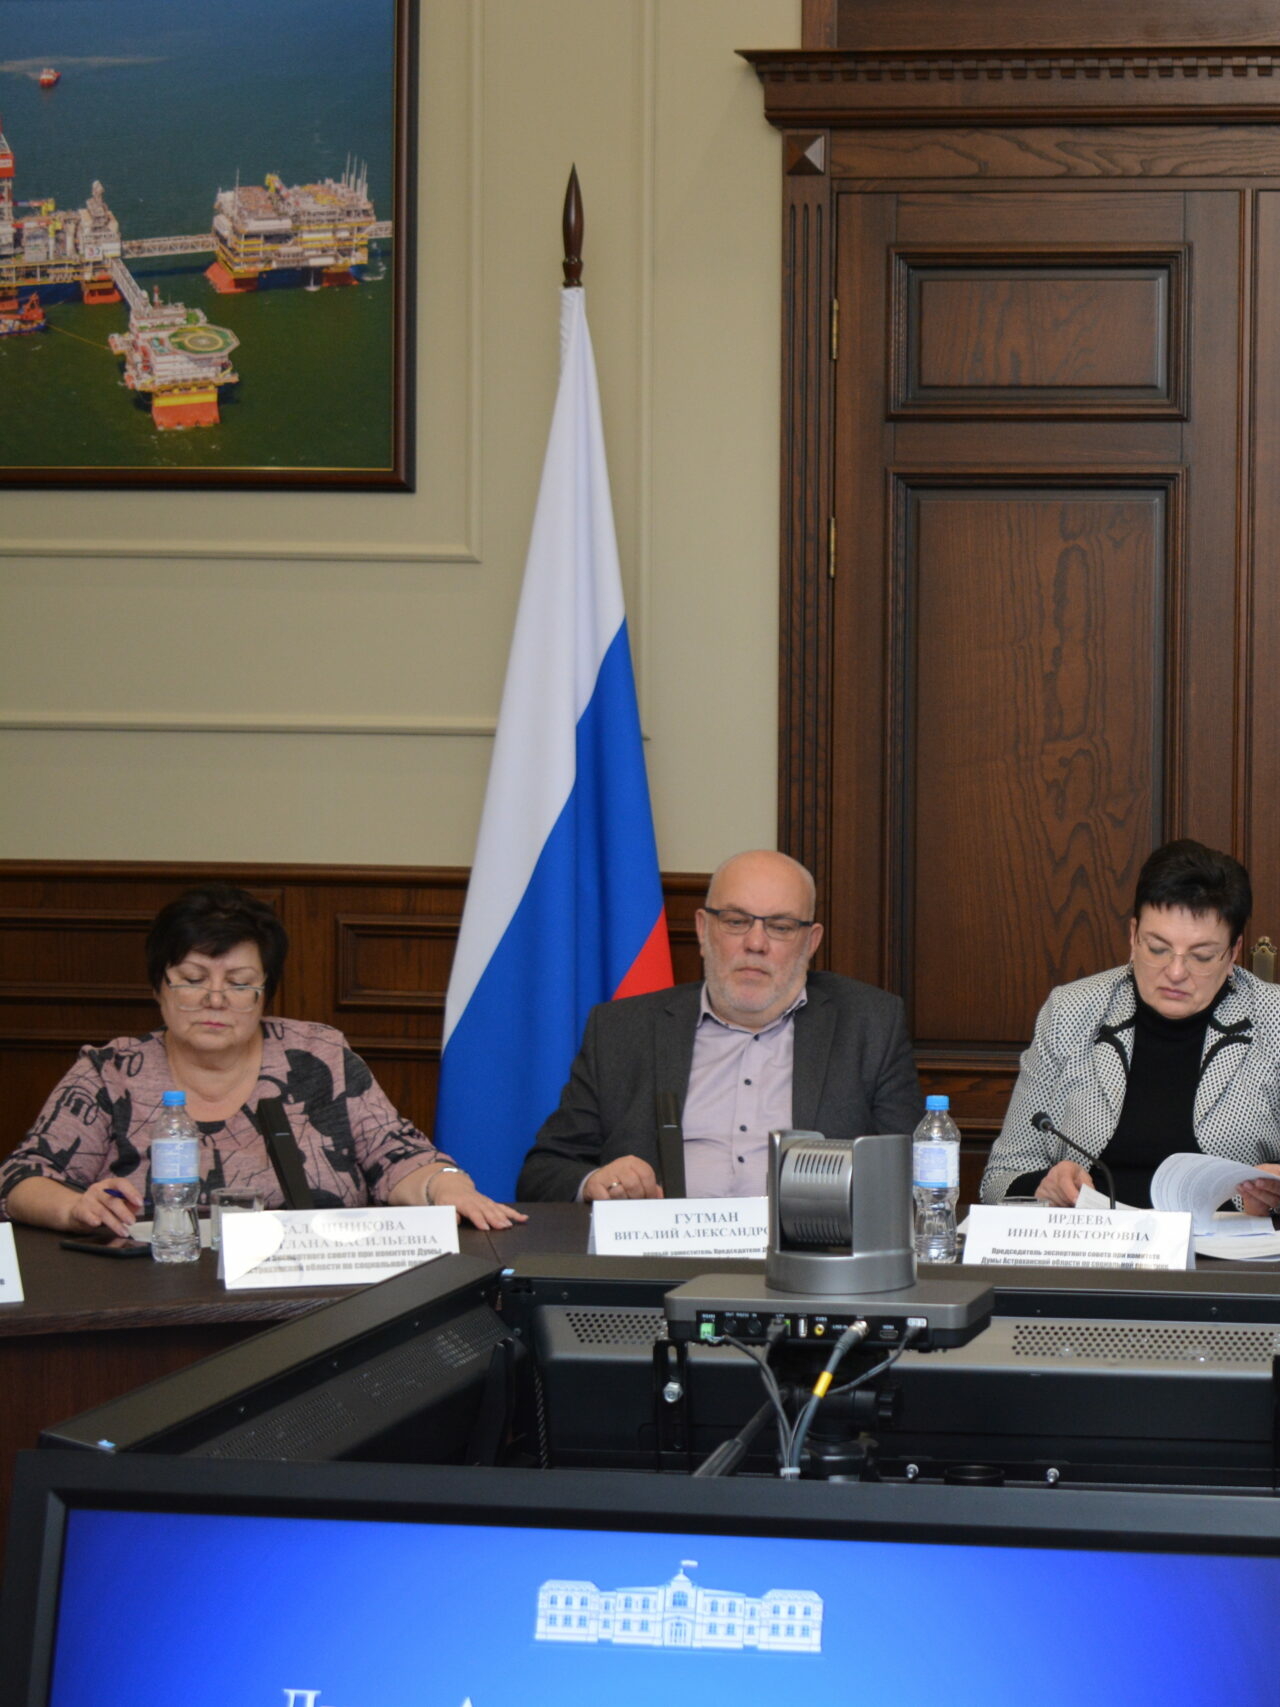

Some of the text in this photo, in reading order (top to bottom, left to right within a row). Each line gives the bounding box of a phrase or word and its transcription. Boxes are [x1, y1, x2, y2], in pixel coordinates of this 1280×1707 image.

[675, 1212, 738, 1224] ГУТМАН
[1048, 1214, 1112, 1226] ИРДЕЕВА
[614, 1228, 679, 1240] ВИТАЛИЙ
[1008, 1228, 1150, 1242] ИННА ВИКТОРОВНА
